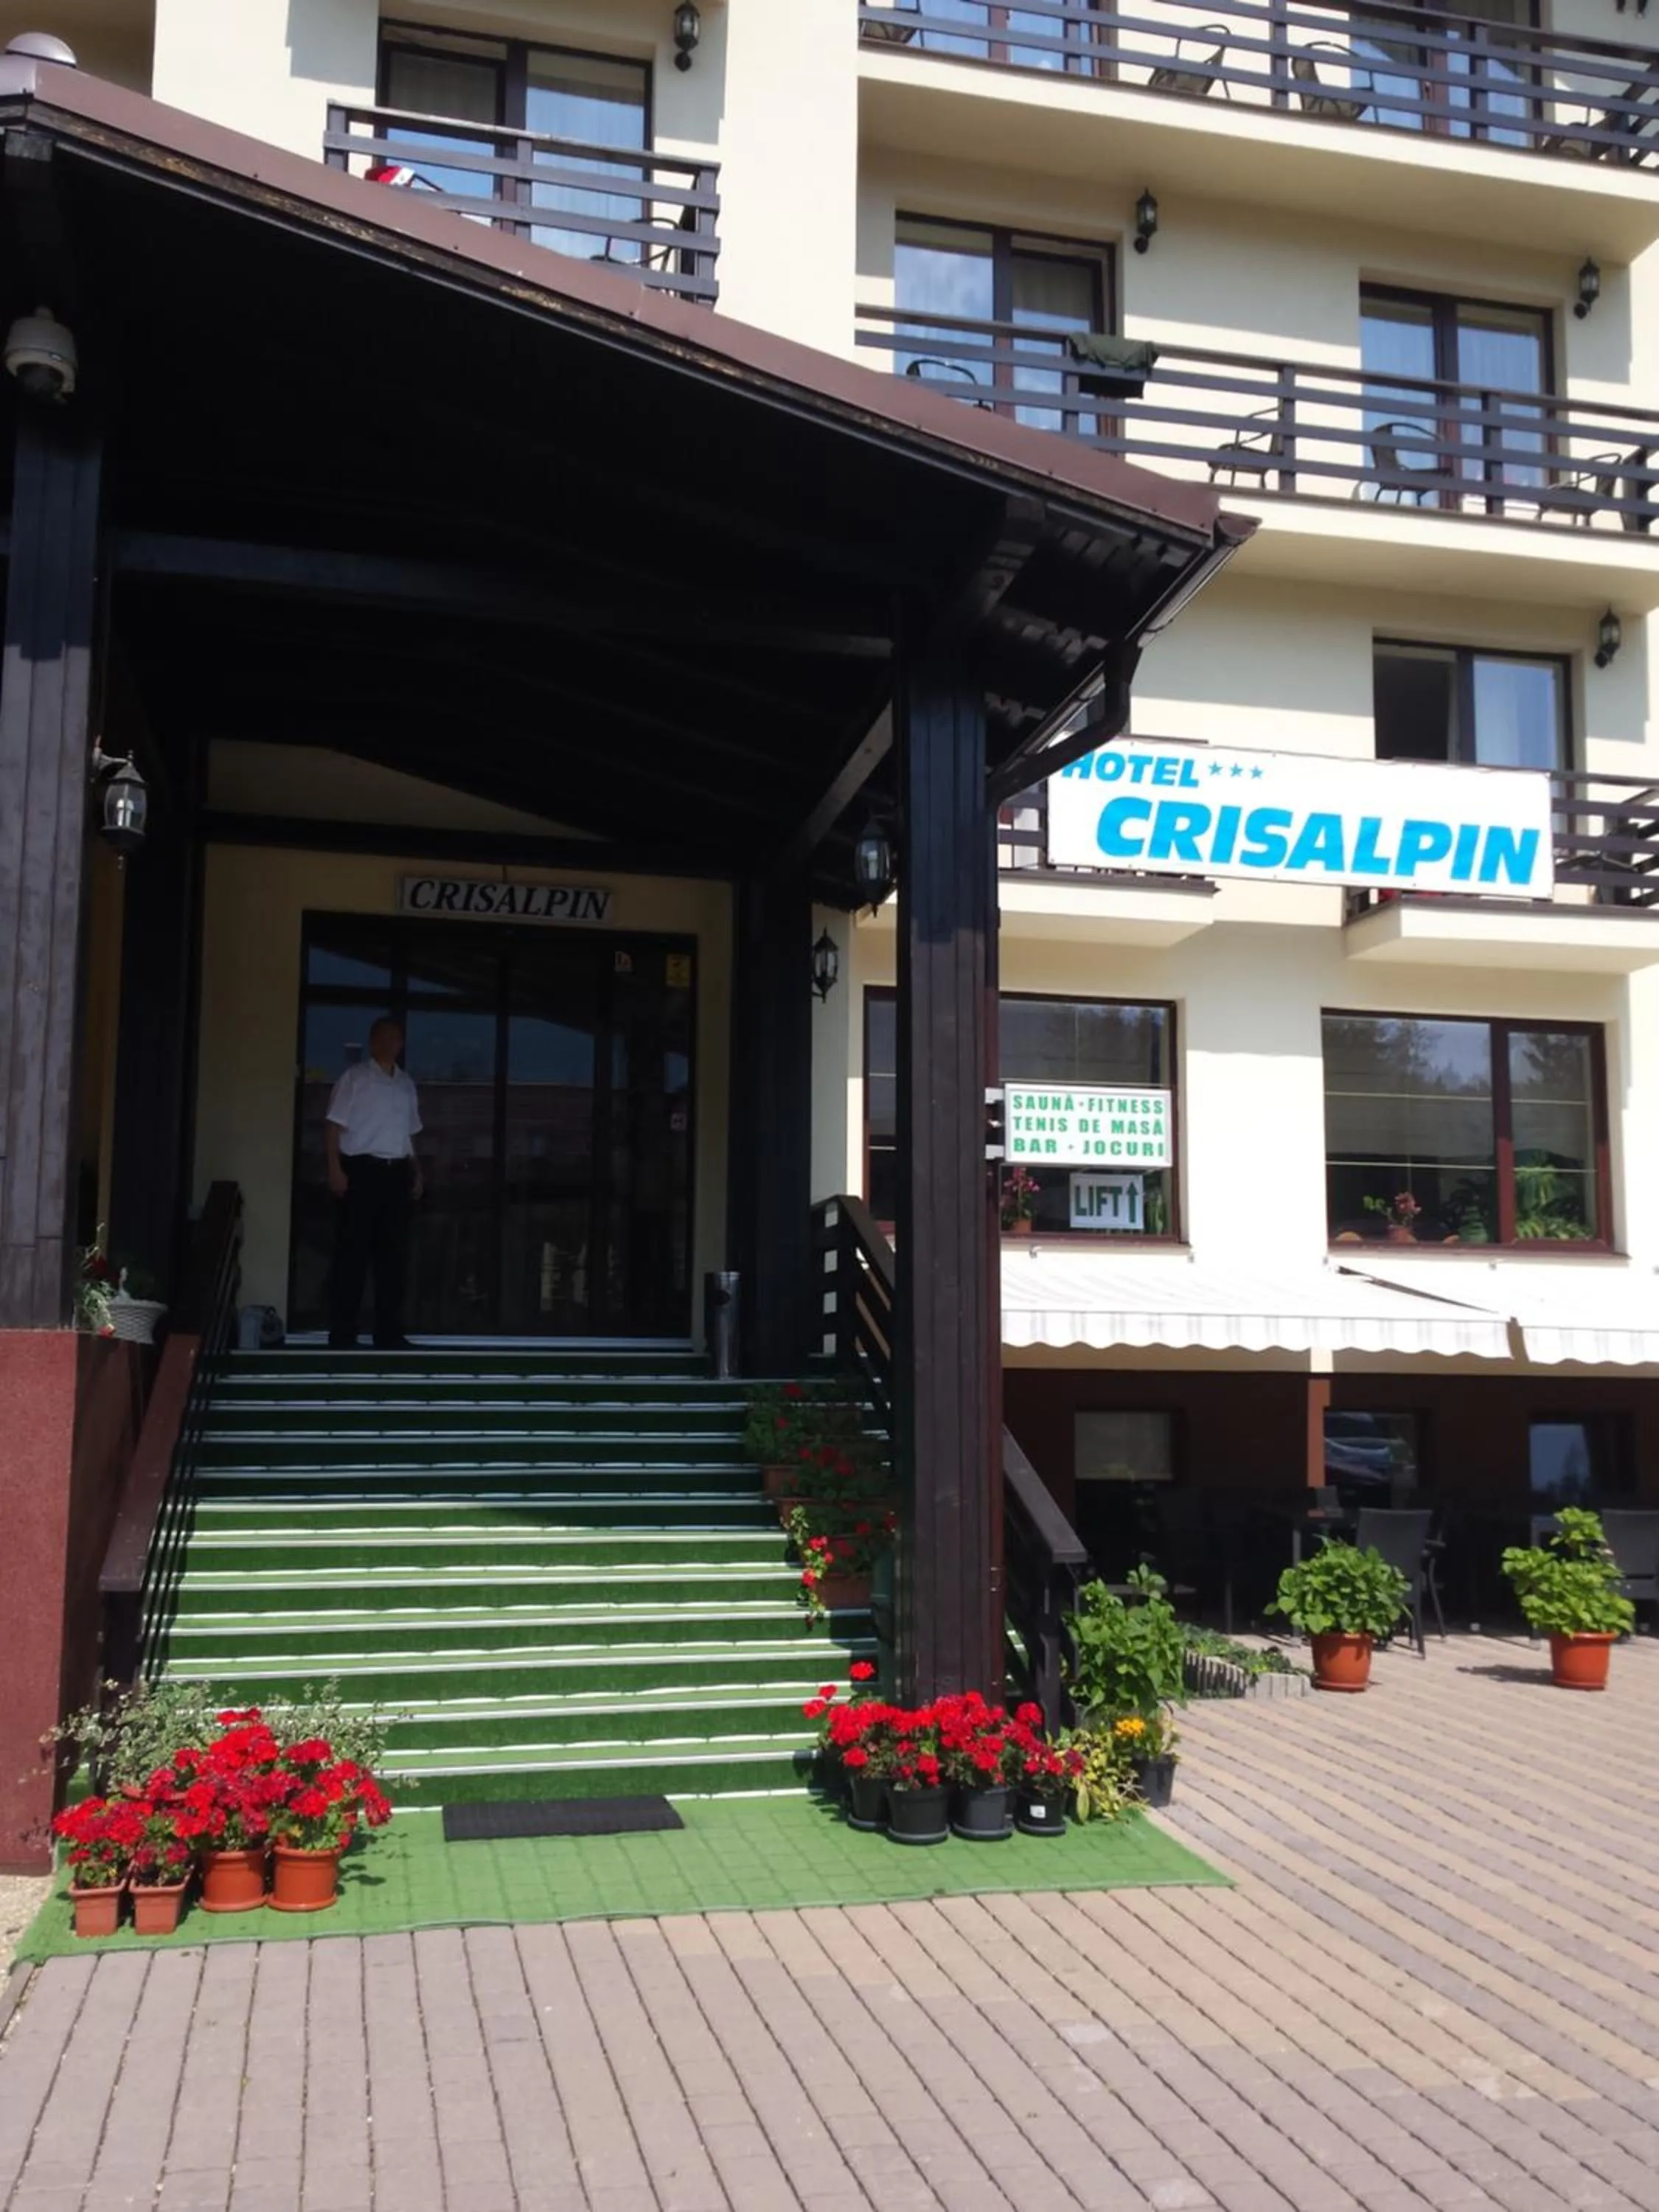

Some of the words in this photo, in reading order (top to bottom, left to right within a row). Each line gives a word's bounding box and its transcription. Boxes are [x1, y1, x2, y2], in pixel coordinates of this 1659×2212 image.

[1062, 751, 1200, 787] HOTEL
[1096, 797, 1540, 885] CRISALPIN
[410, 880, 611, 919] CRISALPIN
[1088, 1098, 1164, 1114] FITNESS
[1013, 1116, 1068, 1133] TENIS
[1079, 1119, 1101, 1133] DE
[1013, 1138, 1057, 1154] BAR
[1083, 1140, 1164, 1157] JOCURI
[1074, 1185, 1122, 1217] LIFT
